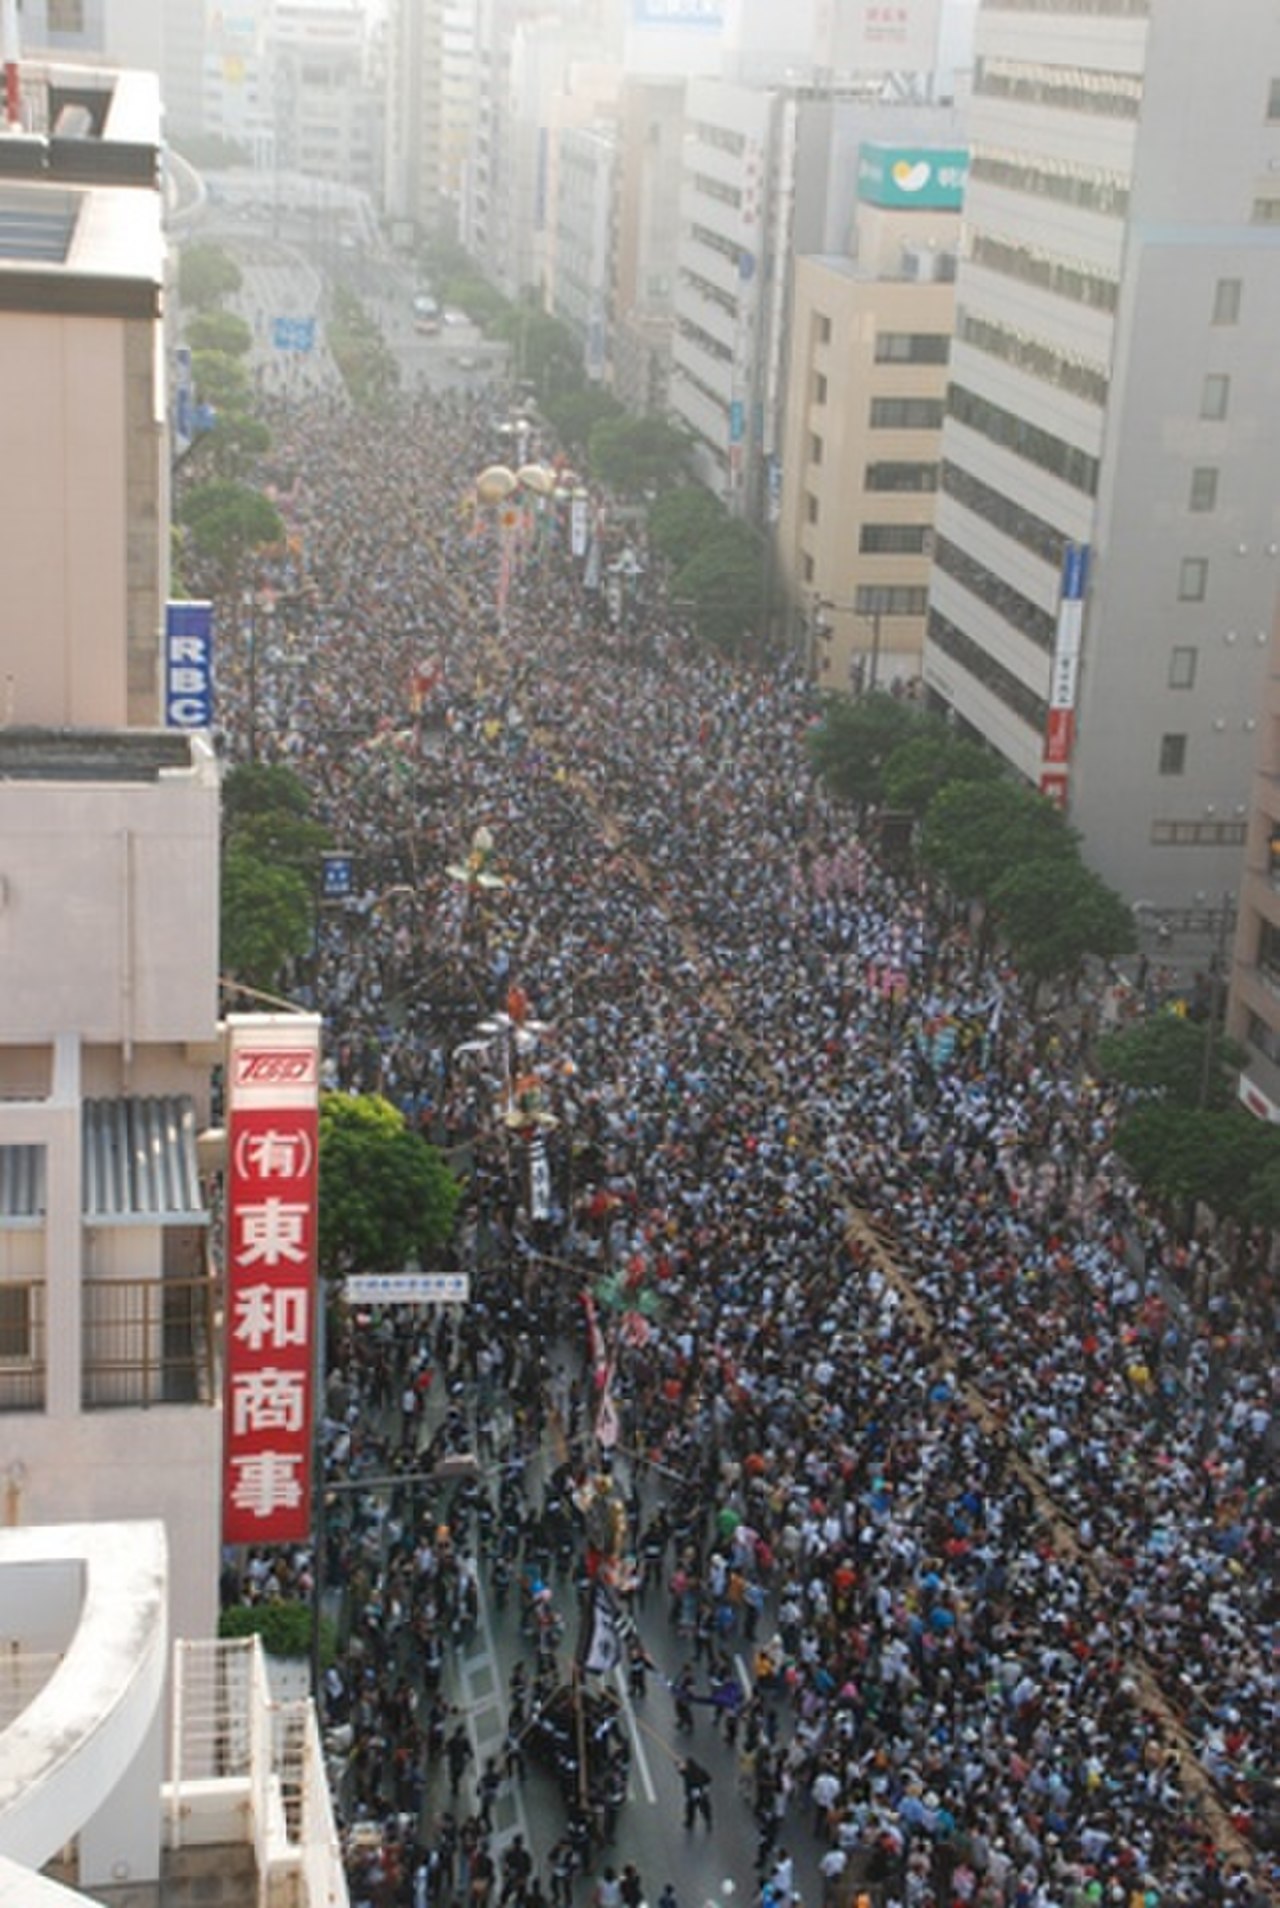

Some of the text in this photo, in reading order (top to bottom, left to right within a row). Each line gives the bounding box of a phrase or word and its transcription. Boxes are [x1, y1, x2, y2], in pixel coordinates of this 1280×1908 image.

[169, 635, 207, 725] RBC
[230, 1129, 312, 1518] (有)東和商事
